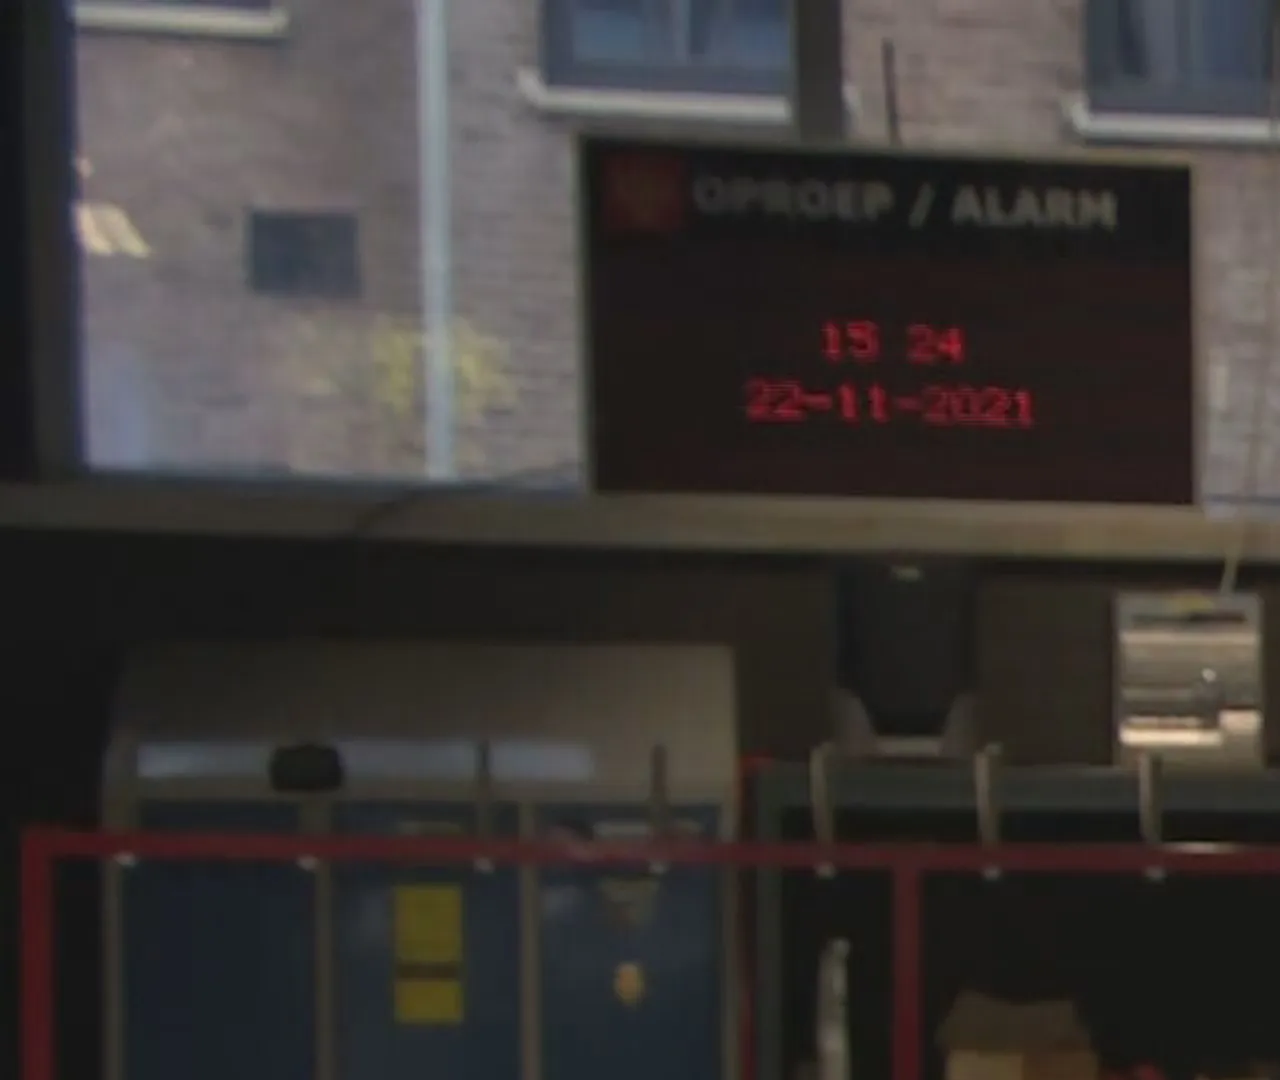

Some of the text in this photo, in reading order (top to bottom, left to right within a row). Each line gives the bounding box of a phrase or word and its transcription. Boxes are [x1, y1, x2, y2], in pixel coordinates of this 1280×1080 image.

[693, 177, 1118, 229] OPROEP / ALARM
[822, 321, 964, 364] 15 24
[745, 379, 1033, 426] 22-11-2021
